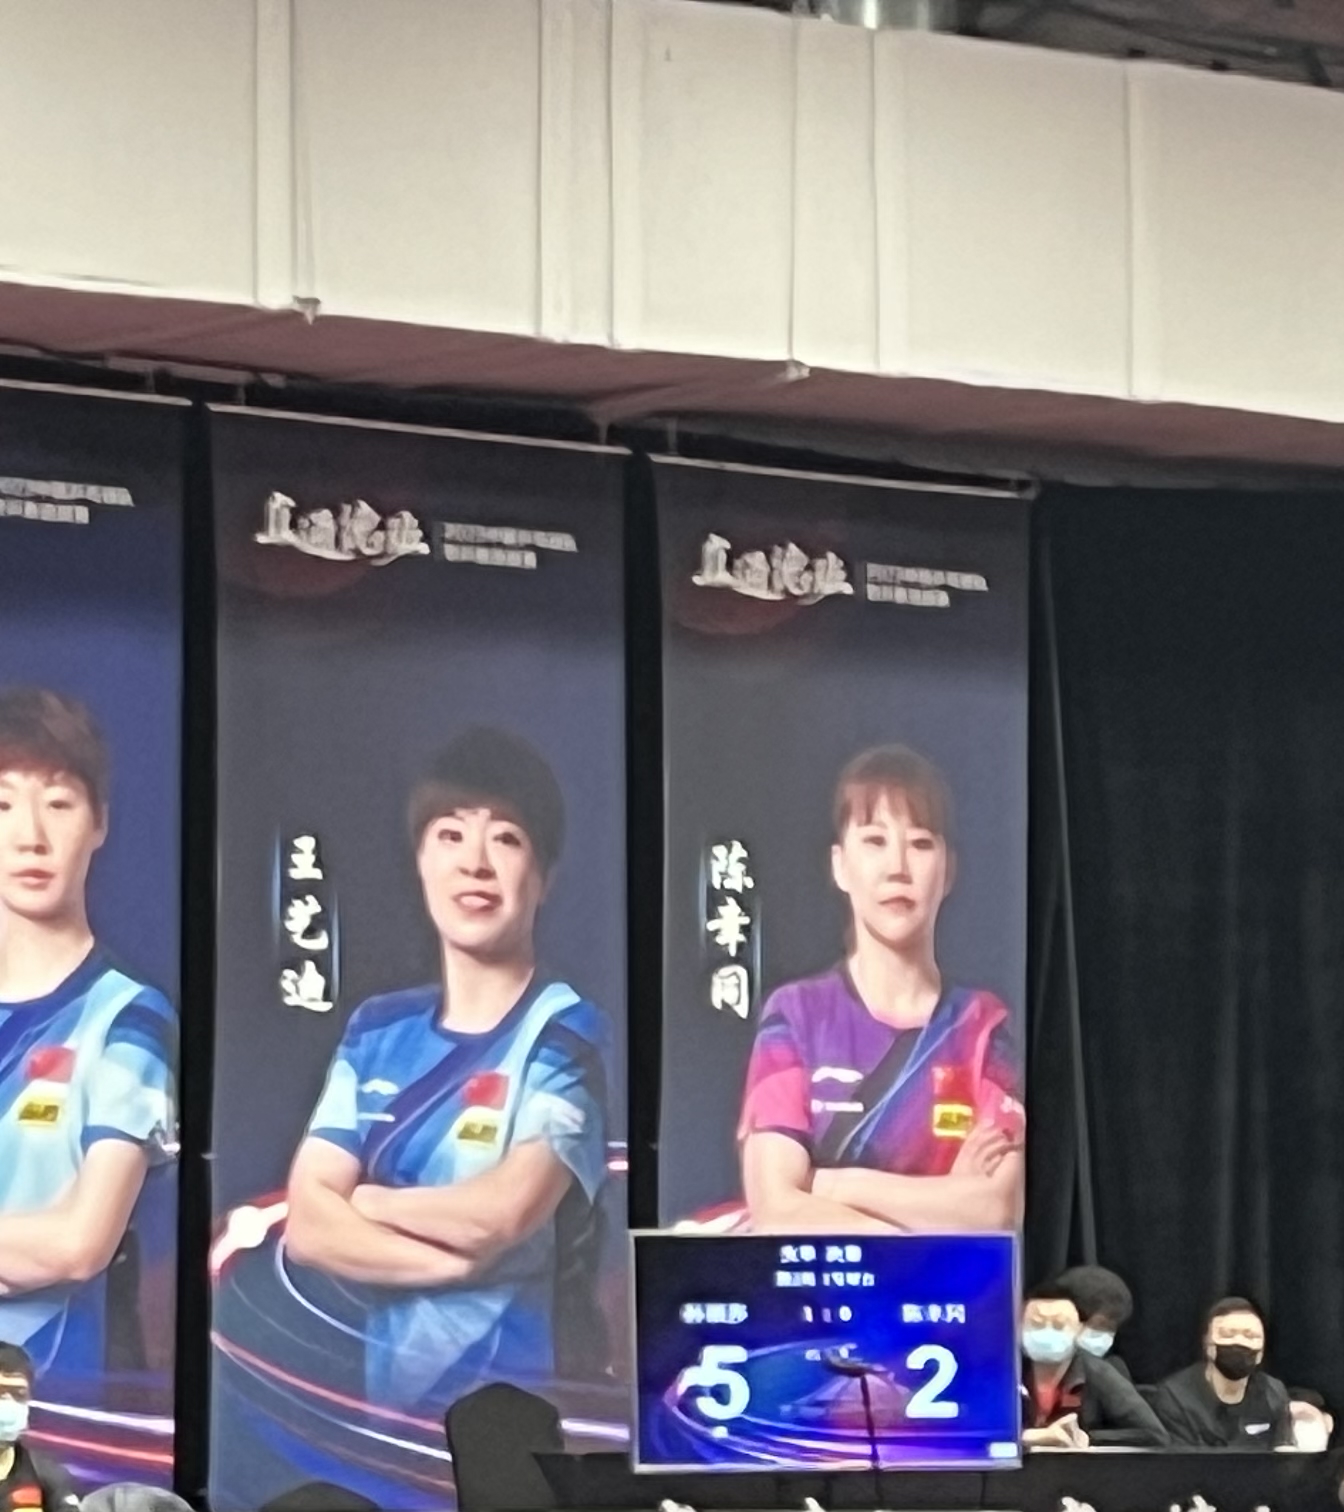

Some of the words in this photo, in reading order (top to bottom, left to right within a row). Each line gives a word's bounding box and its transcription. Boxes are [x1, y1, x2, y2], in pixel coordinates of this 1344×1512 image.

[706, 839, 755, 1020] 陈幸同
[696, 1344, 750, 1420] 5
[905, 1344, 959, 1418] 2
